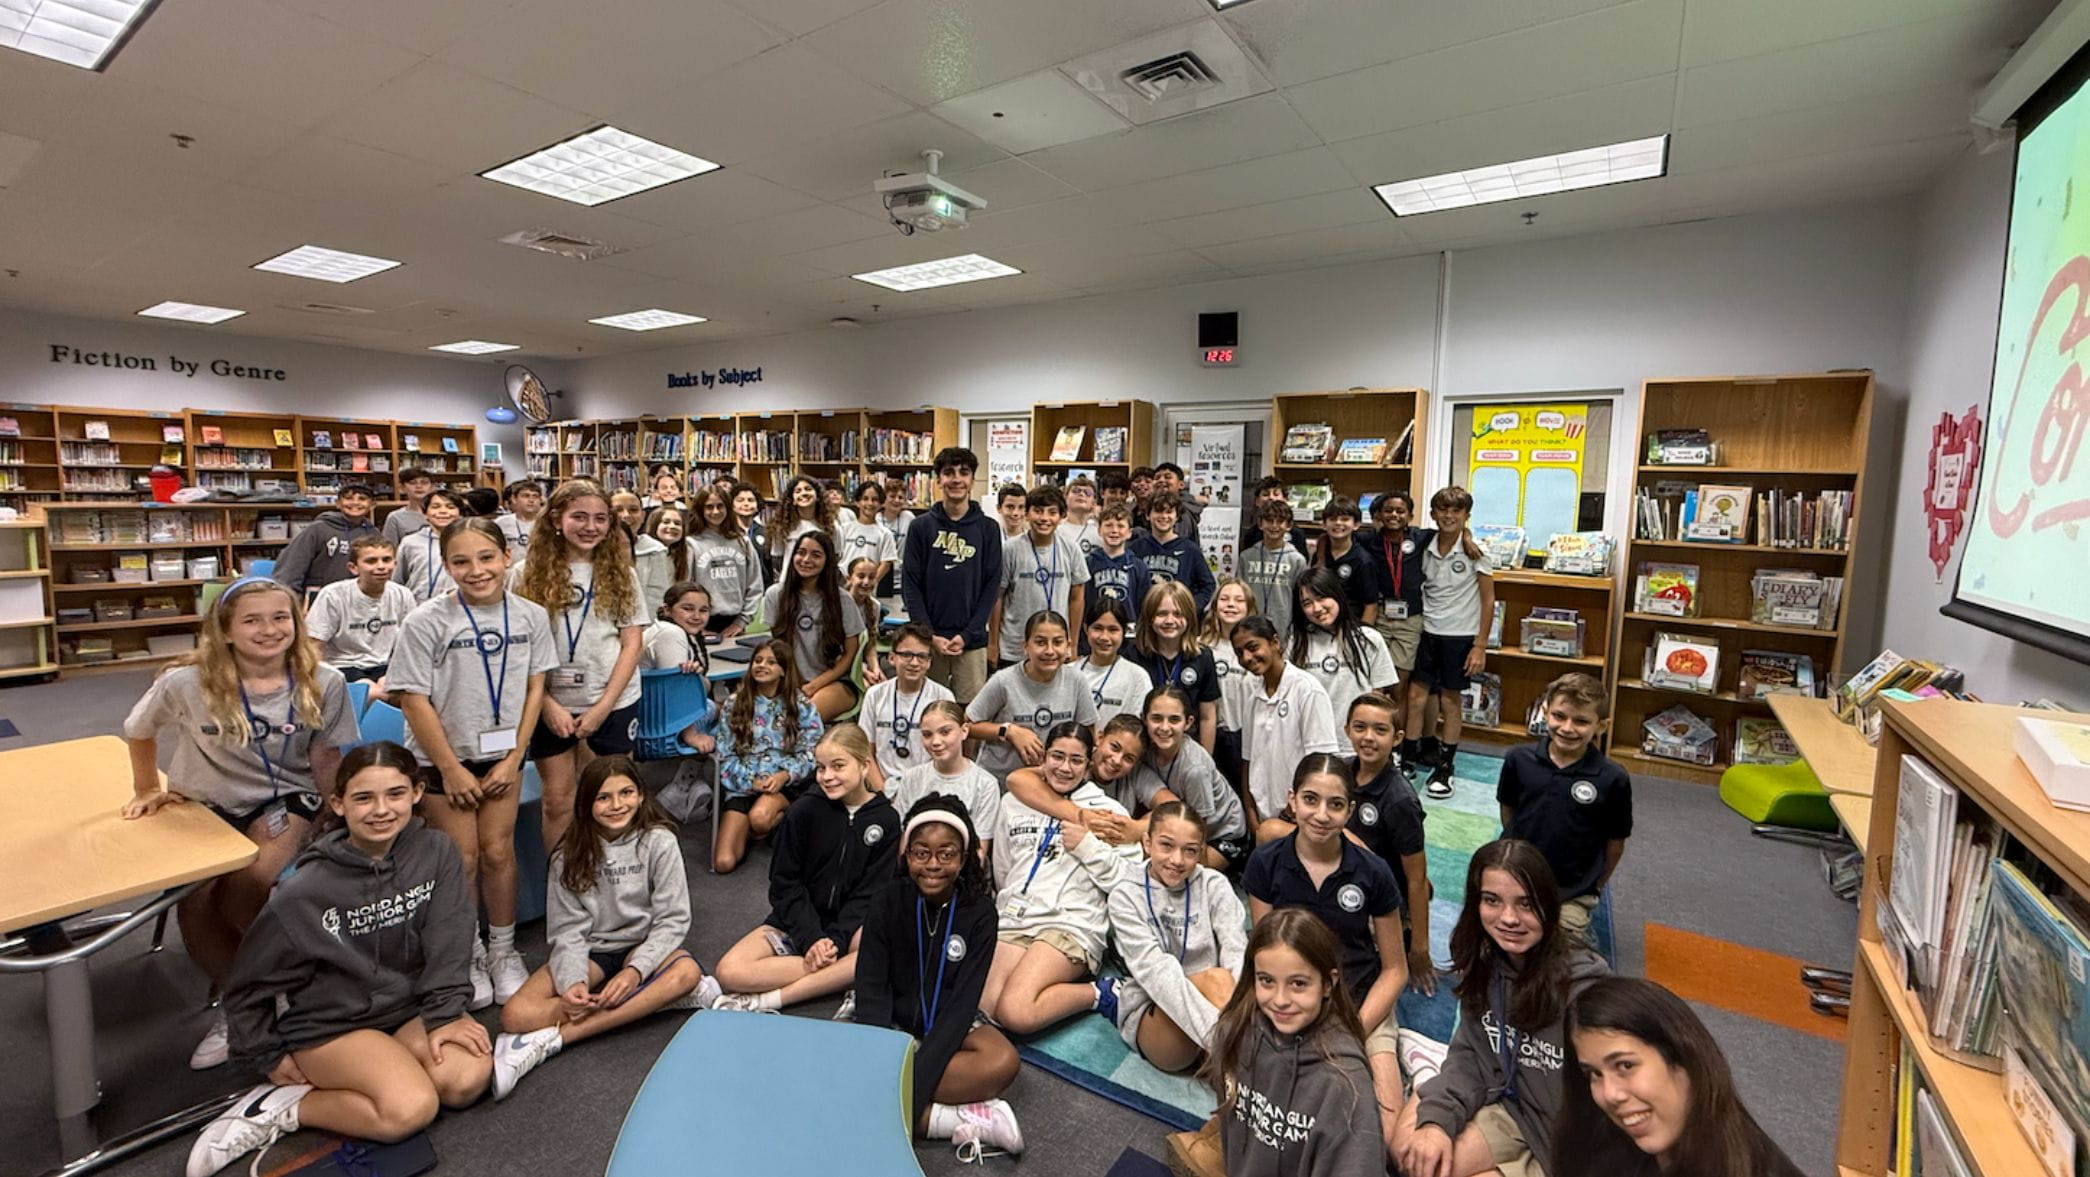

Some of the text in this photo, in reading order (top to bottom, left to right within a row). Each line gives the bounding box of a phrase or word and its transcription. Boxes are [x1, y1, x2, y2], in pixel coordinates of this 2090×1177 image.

[50, 344, 287, 381] Fiction by Genre
[667, 367, 763, 389] Books by Subject
[1248, 560, 1291, 575] NBP
[1770, 583, 1820, 597] DIARY
